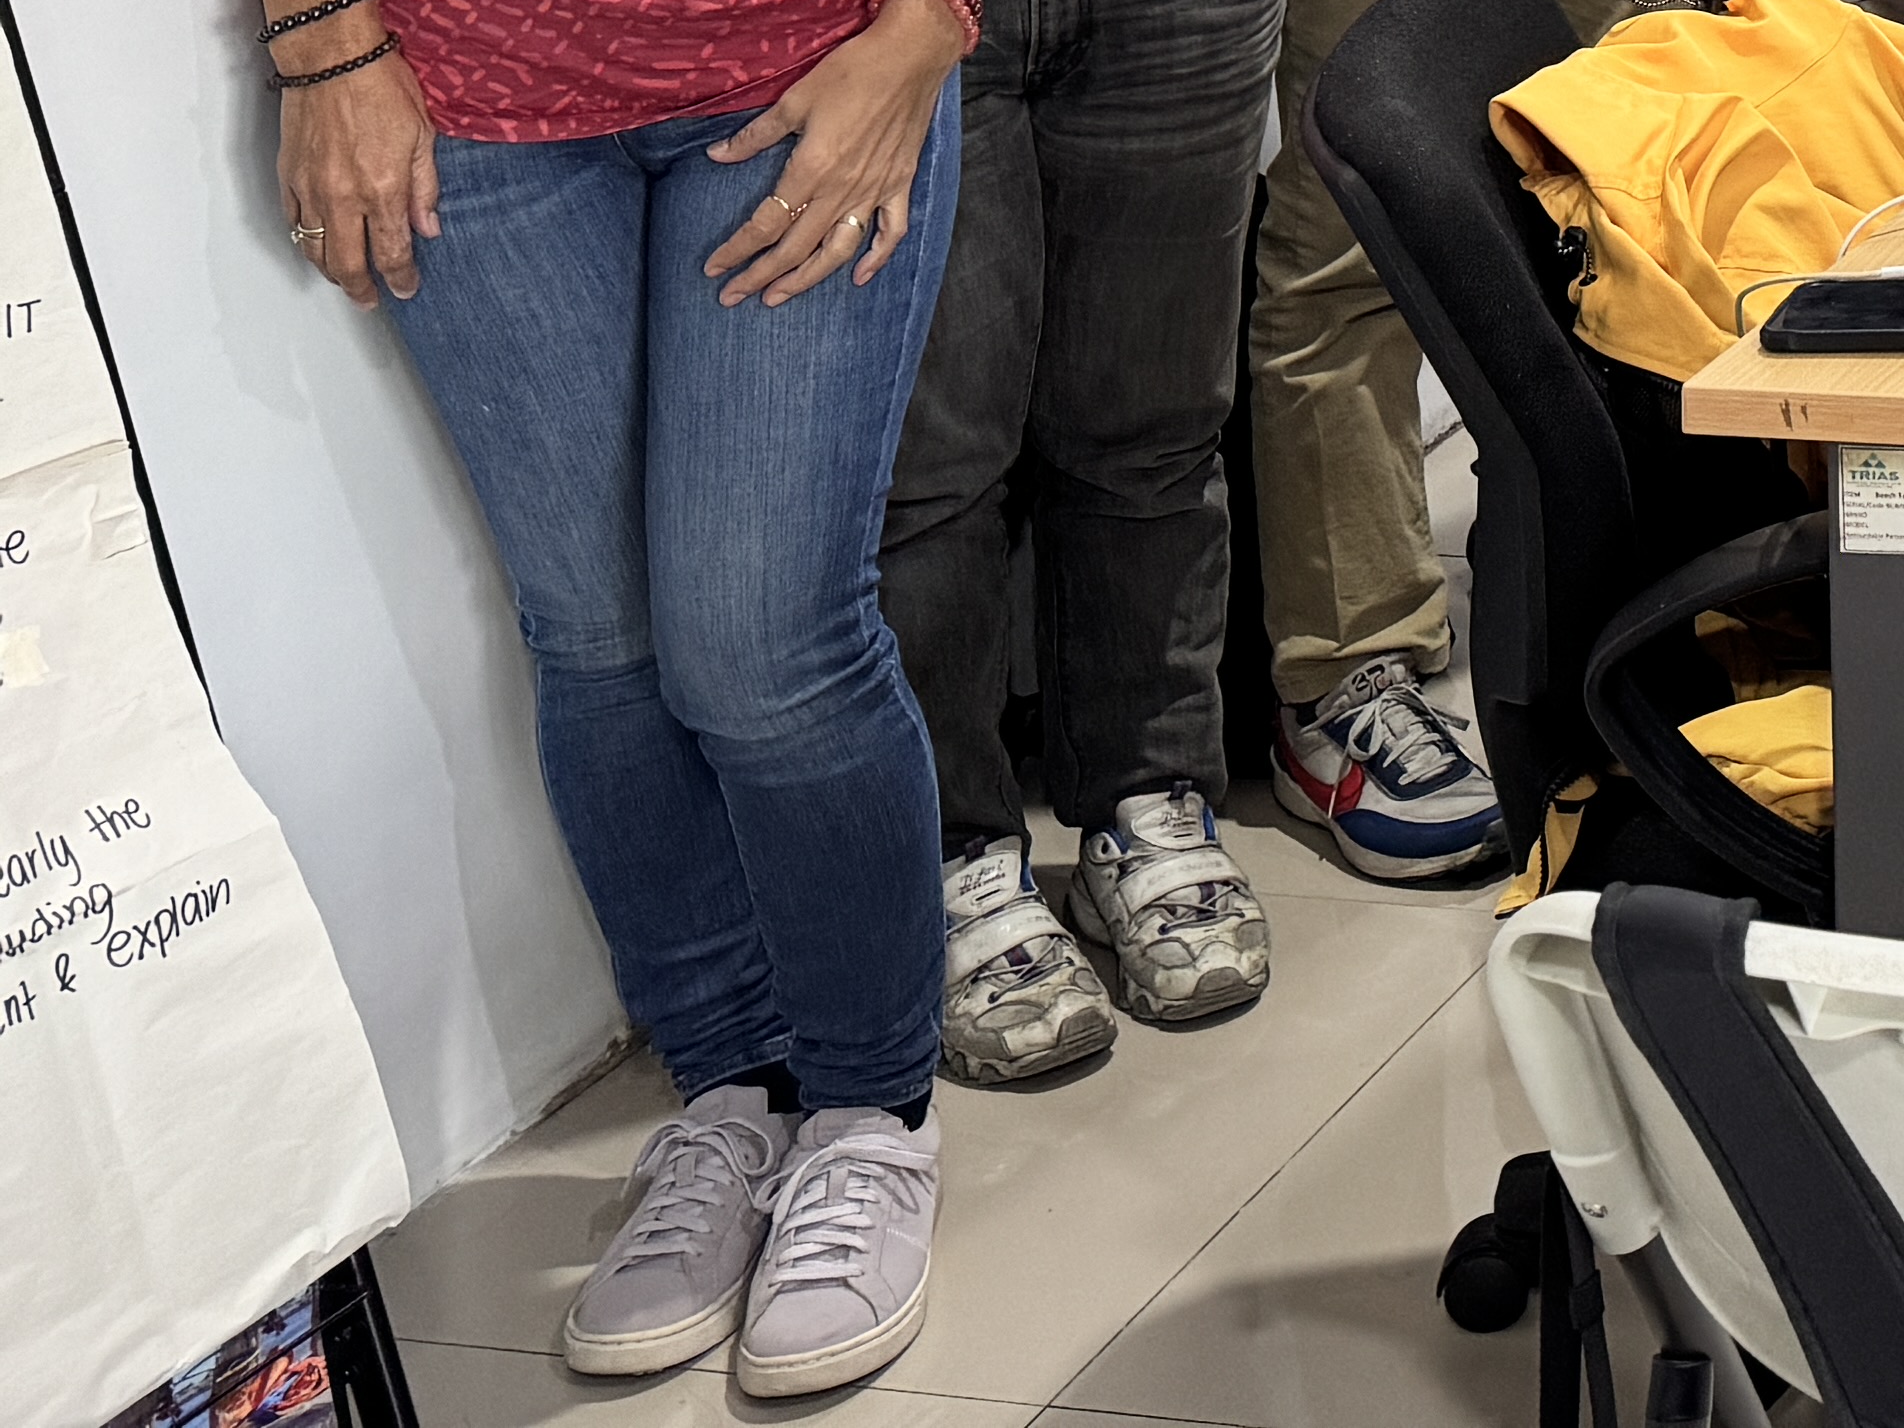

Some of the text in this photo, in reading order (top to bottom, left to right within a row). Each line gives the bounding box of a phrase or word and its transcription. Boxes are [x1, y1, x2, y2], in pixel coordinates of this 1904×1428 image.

[6, 299, 41, 338] IT
[1850, 470, 1900, 481] TRIAS
[84, 798, 151, 842] the
[54, 953, 76, 992] &
[107, 878, 230, 967] explain
